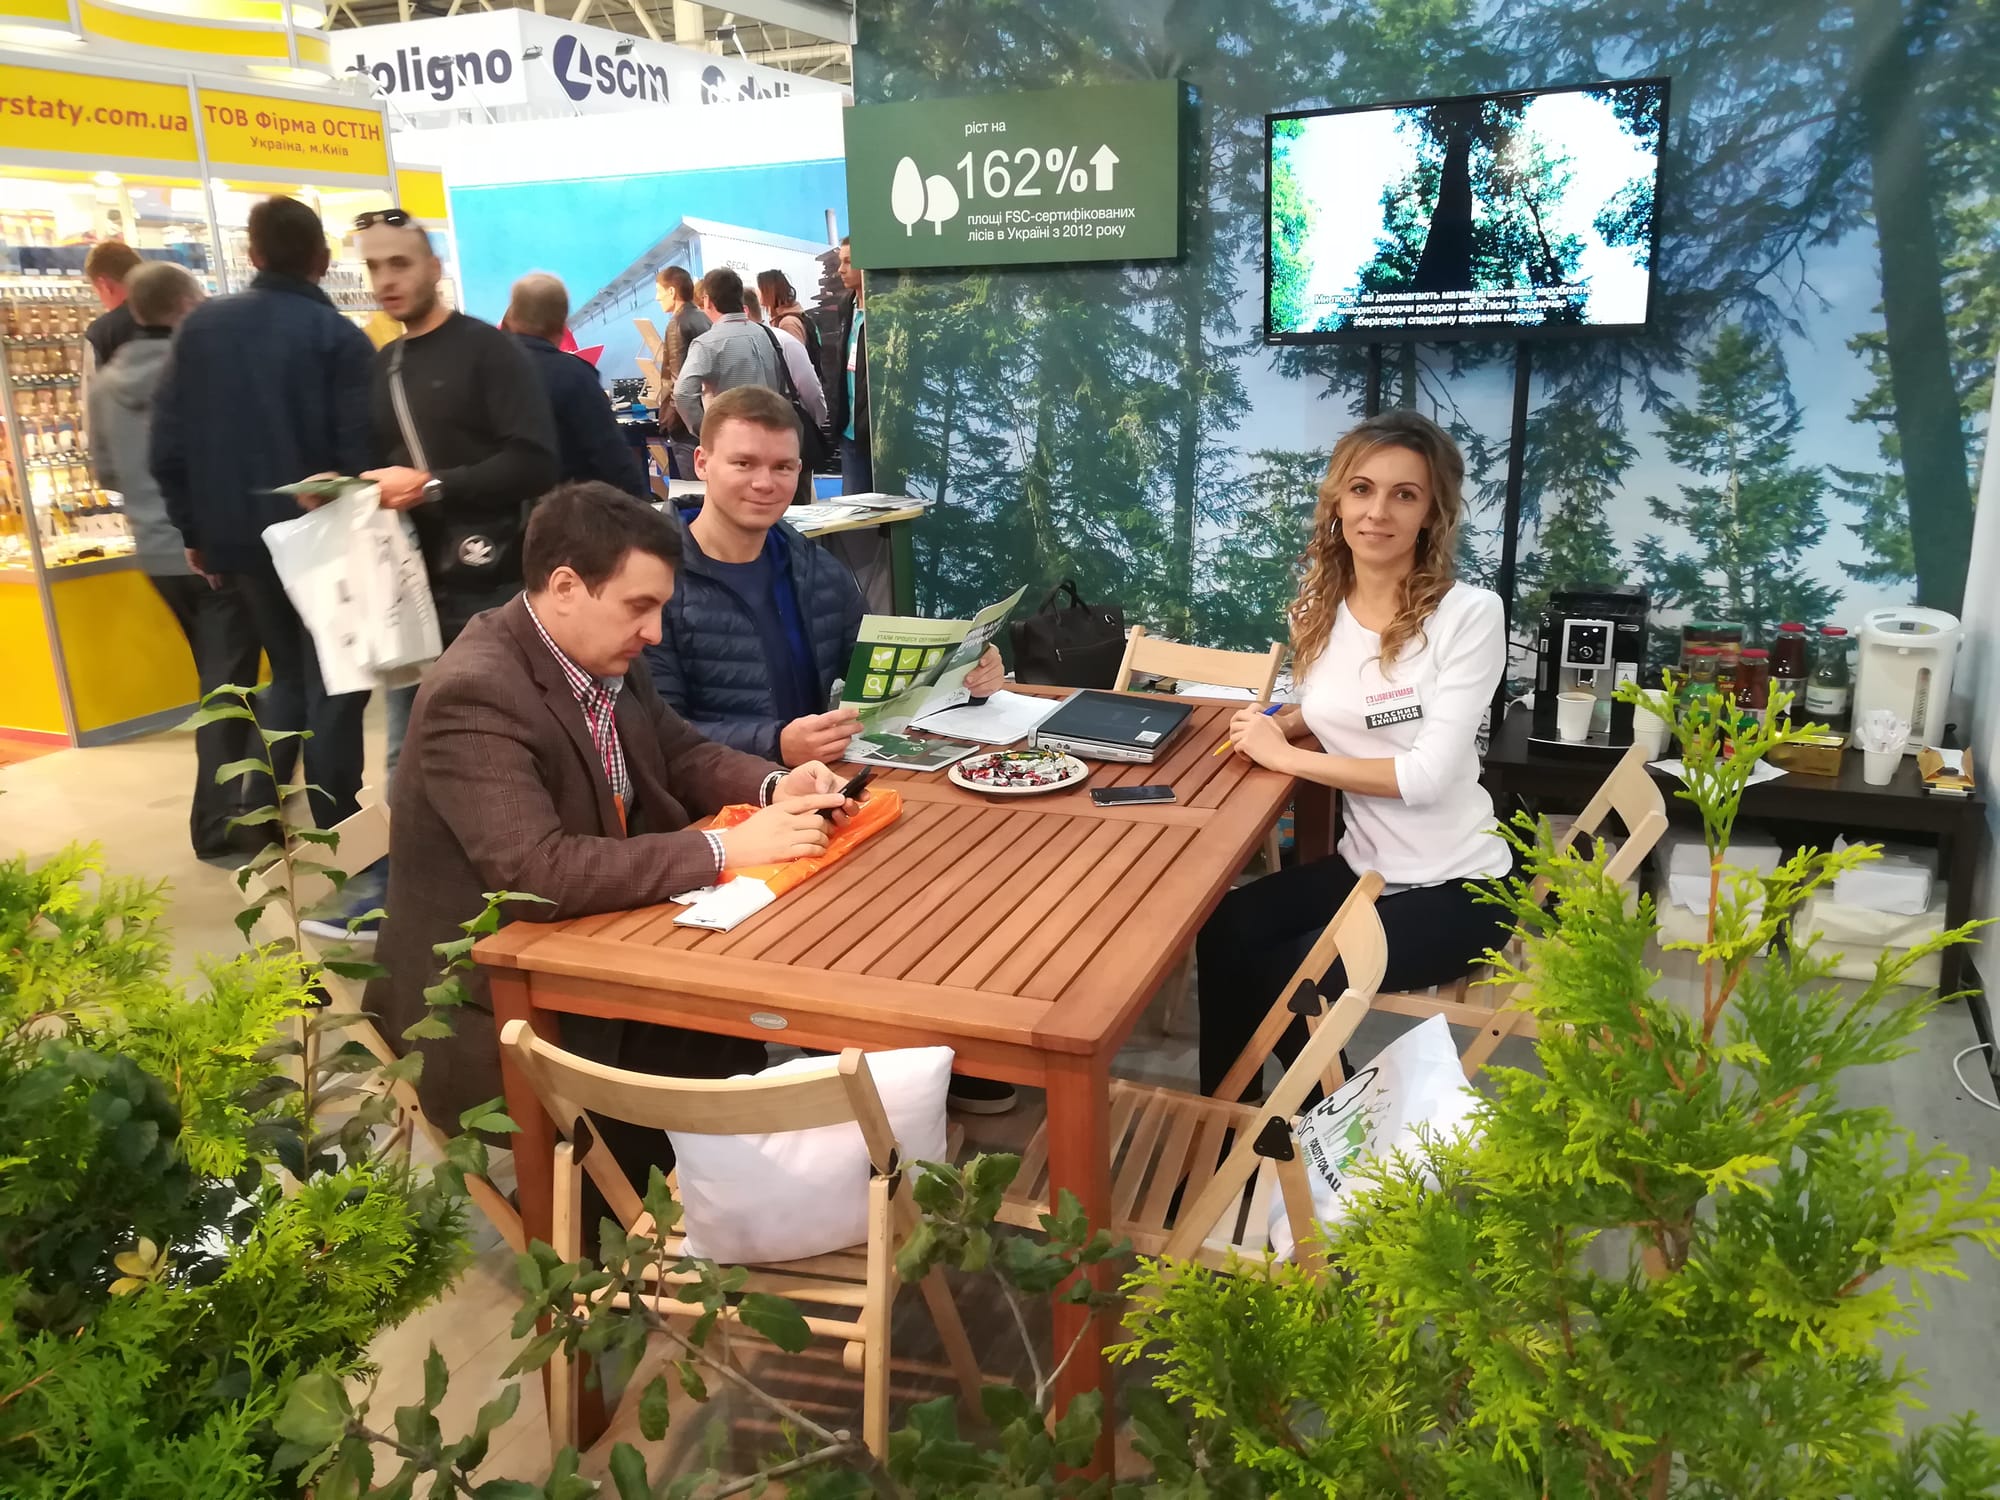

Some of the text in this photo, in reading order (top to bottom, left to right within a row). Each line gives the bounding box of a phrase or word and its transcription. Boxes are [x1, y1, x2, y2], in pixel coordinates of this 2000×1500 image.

[595, 54, 669, 103] scm
[0, 95, 188, 131] rstaty.com.ua
[204, 105, 380, 141] ТОВ Фірма ОСТІН
[965, 121, 1006, 137] ріст на
[250, 136, 349, 156] Україна, м.Київ
[956, 146, 1088, 199] 162%
[967, 207, 1135, 226] площі FSC-сертифікованих
[967, 224, 1126, 242] лісів в Україні з 2012 року
[1375, 291, 1440, 303] допомагають
[1337, 303, 1415, 316] використовуючи
[1416, 302, 1456, 315] ресурси
[1458, 301, 1485, 312] своїх
[1486, 299, 1510, 311] лісів
[1517, 299, 1567, 310] водночас
[1353, 316, 1406, 328] зберігаючи
[1407, 314, 1458, 326] спадщину
[1458, 313, 1503, 325] корінних
[1370, 706, 1418, 720] УЧАСНИК
[1371, 711, 1419, 727] EXHIBITOR
[1316, 1157, 1329, 1175] FOR
[1325, 1172, 1342, 1192] ALL
